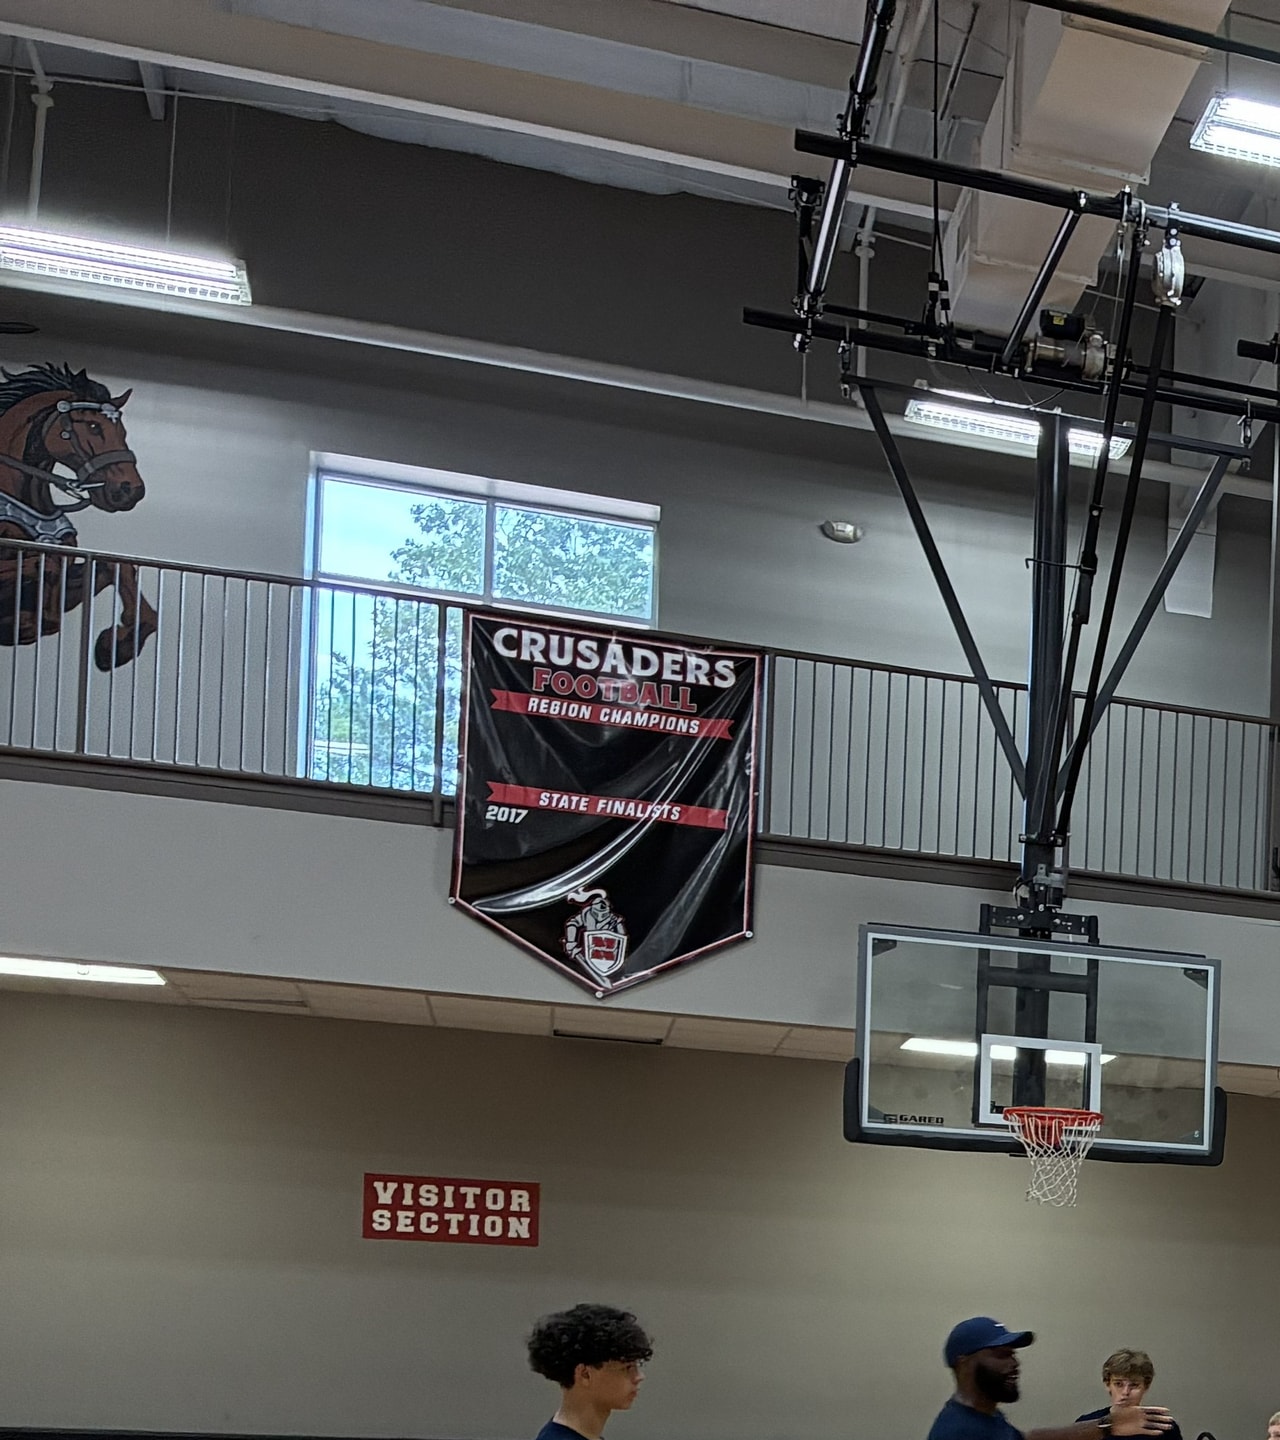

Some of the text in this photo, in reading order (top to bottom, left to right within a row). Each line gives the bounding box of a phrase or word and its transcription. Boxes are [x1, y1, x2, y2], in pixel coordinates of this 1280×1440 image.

[492, 627, 736, 688] CRUSADERS
[533, 667, 697, 713] FOOTBALL
[528, 697, 700, 734] REGION CHAMPIONS
[485, 805, 528, 824] 2017
[539, 792, 681, 821] STATE FINALISTS
[373, 1181, 531, 1212] VISITOR
[372, 1209, 530, 1239] SECTION
